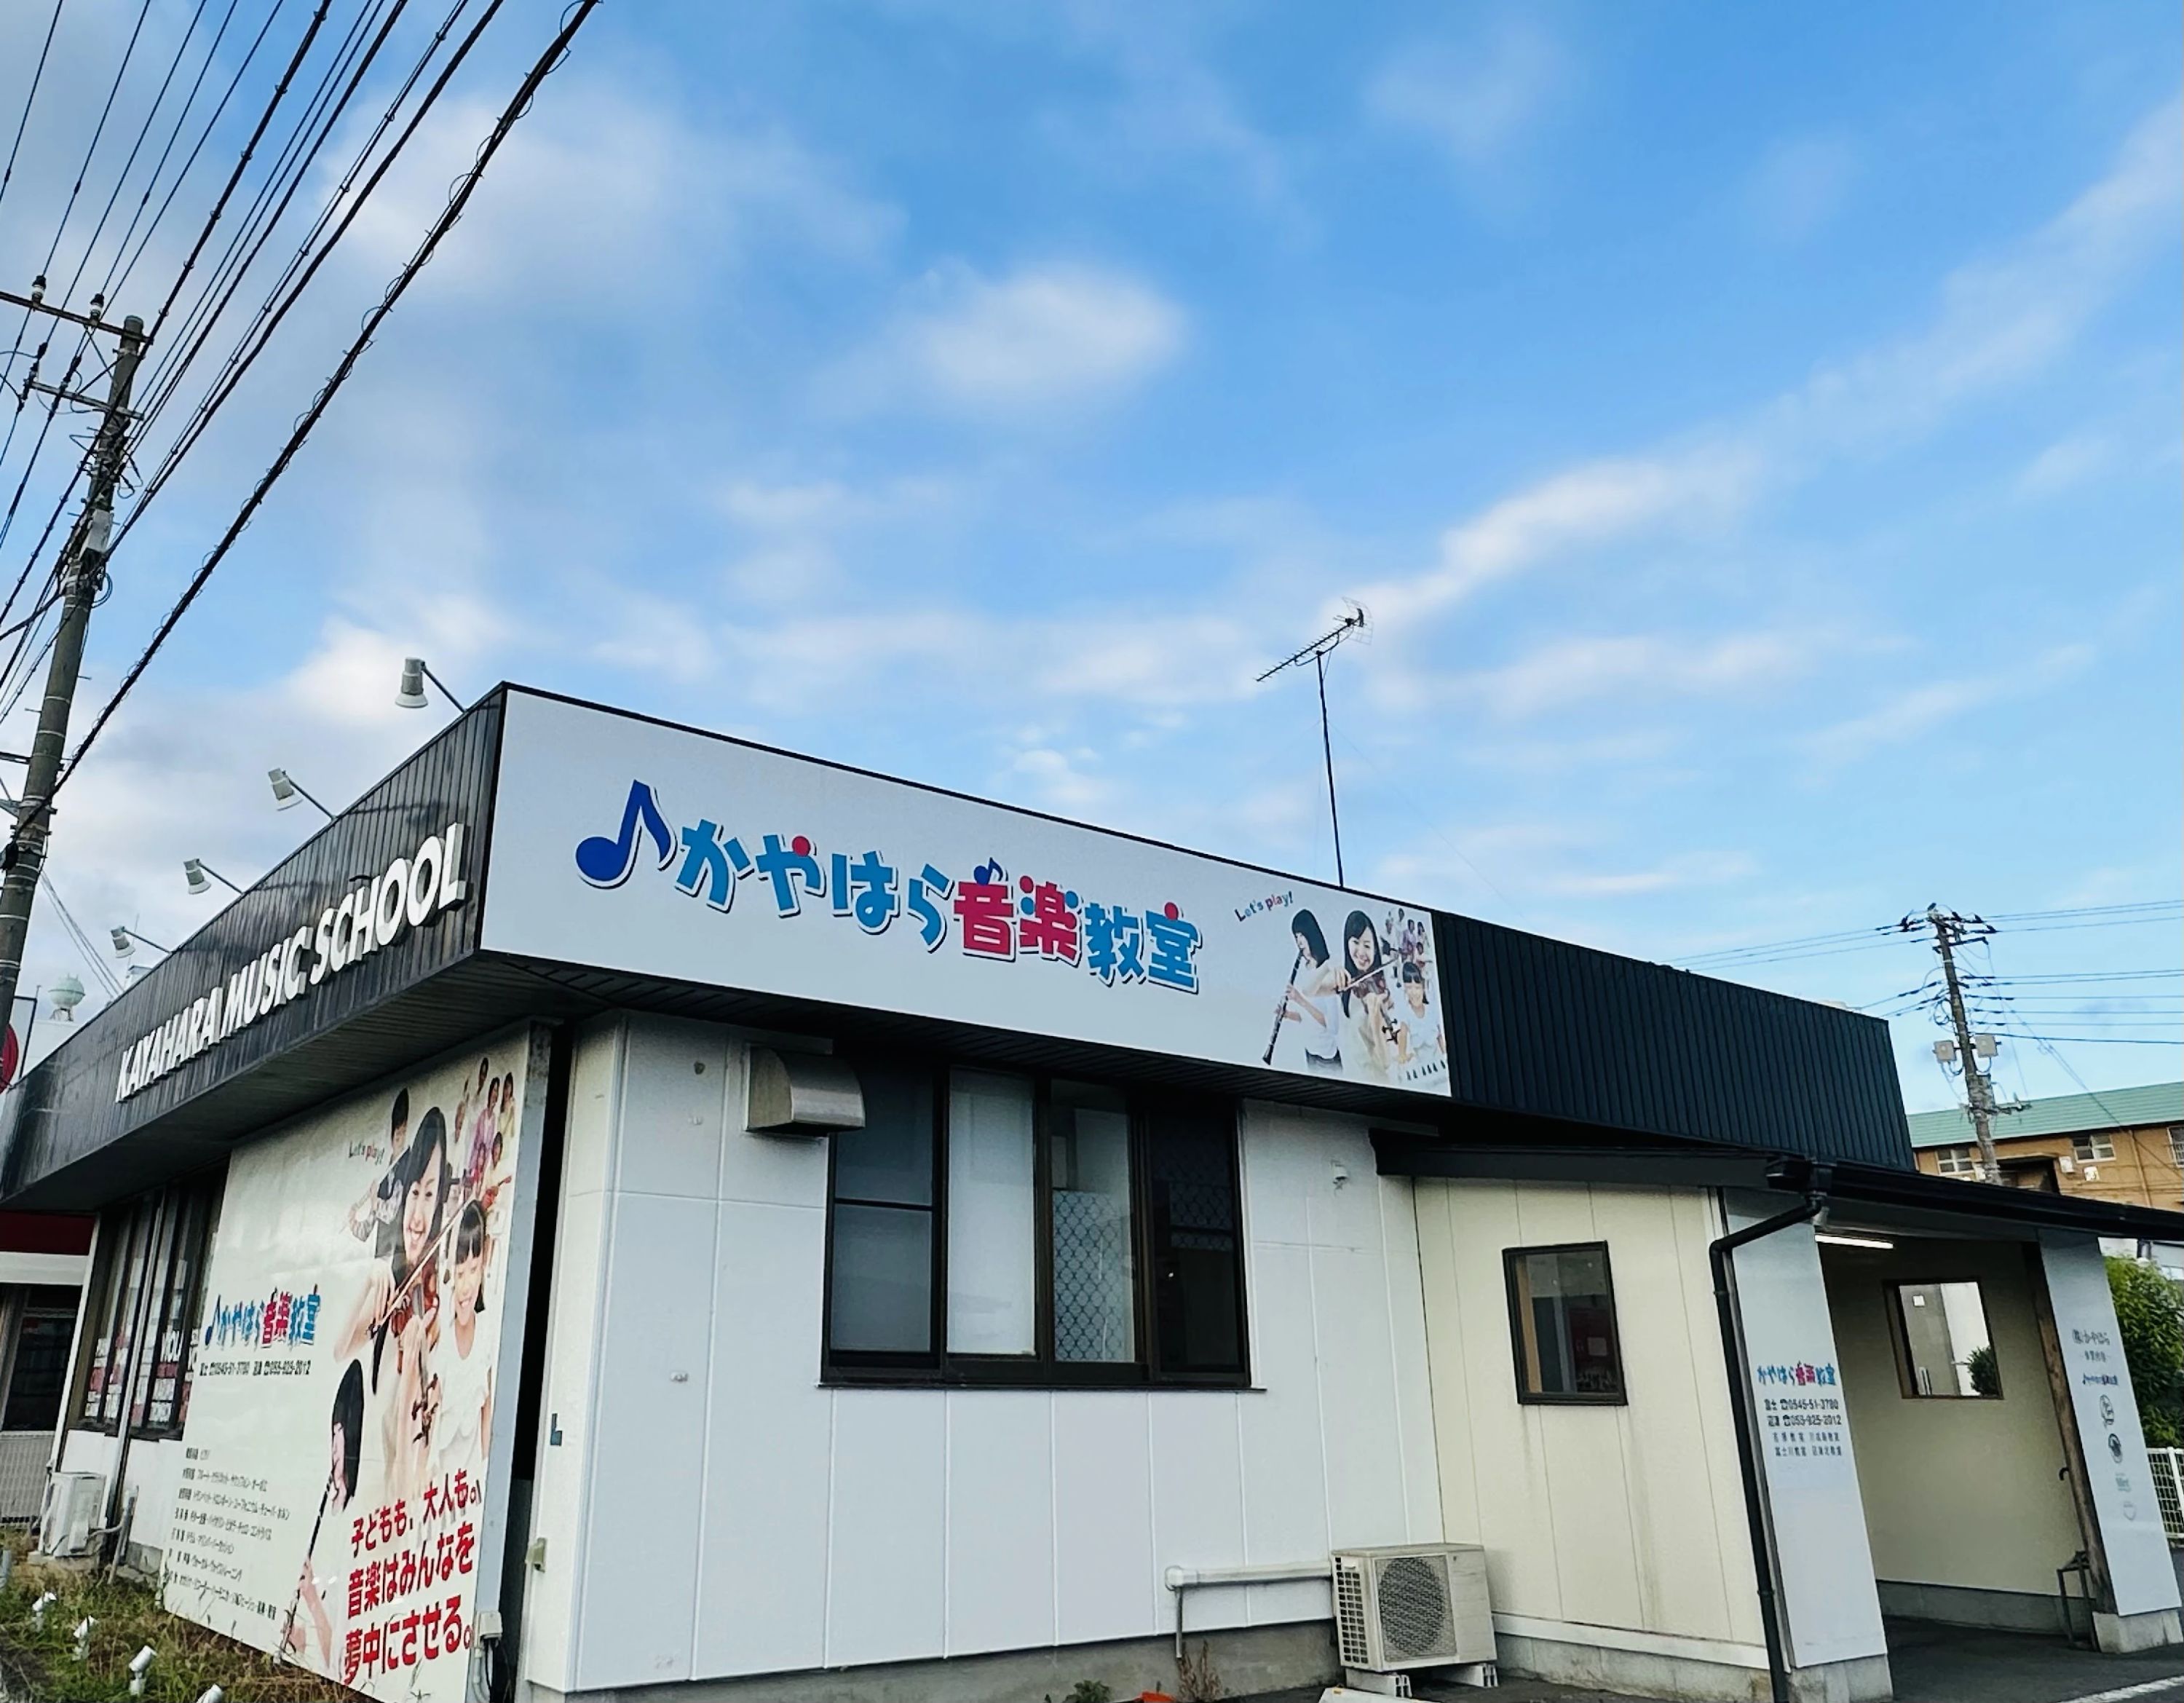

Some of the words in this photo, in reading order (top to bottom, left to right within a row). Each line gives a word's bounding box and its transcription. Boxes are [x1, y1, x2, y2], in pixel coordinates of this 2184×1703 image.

[675, 818, 1203, 993] かやはら音楽教室
[1235, 898, 1264, 922] Let's
[1265, 890, 1294, 912] play!
[115, 987, 223, 1103] KAYAHARA
[221, 926, 313, 1038] MUSIC
[309, 822, 469, 985] SCHOOL
[347, 1521, 474, 1619] 音楽はみんなを
[344, 1595, 472, 1686] 夢中にさせる。
